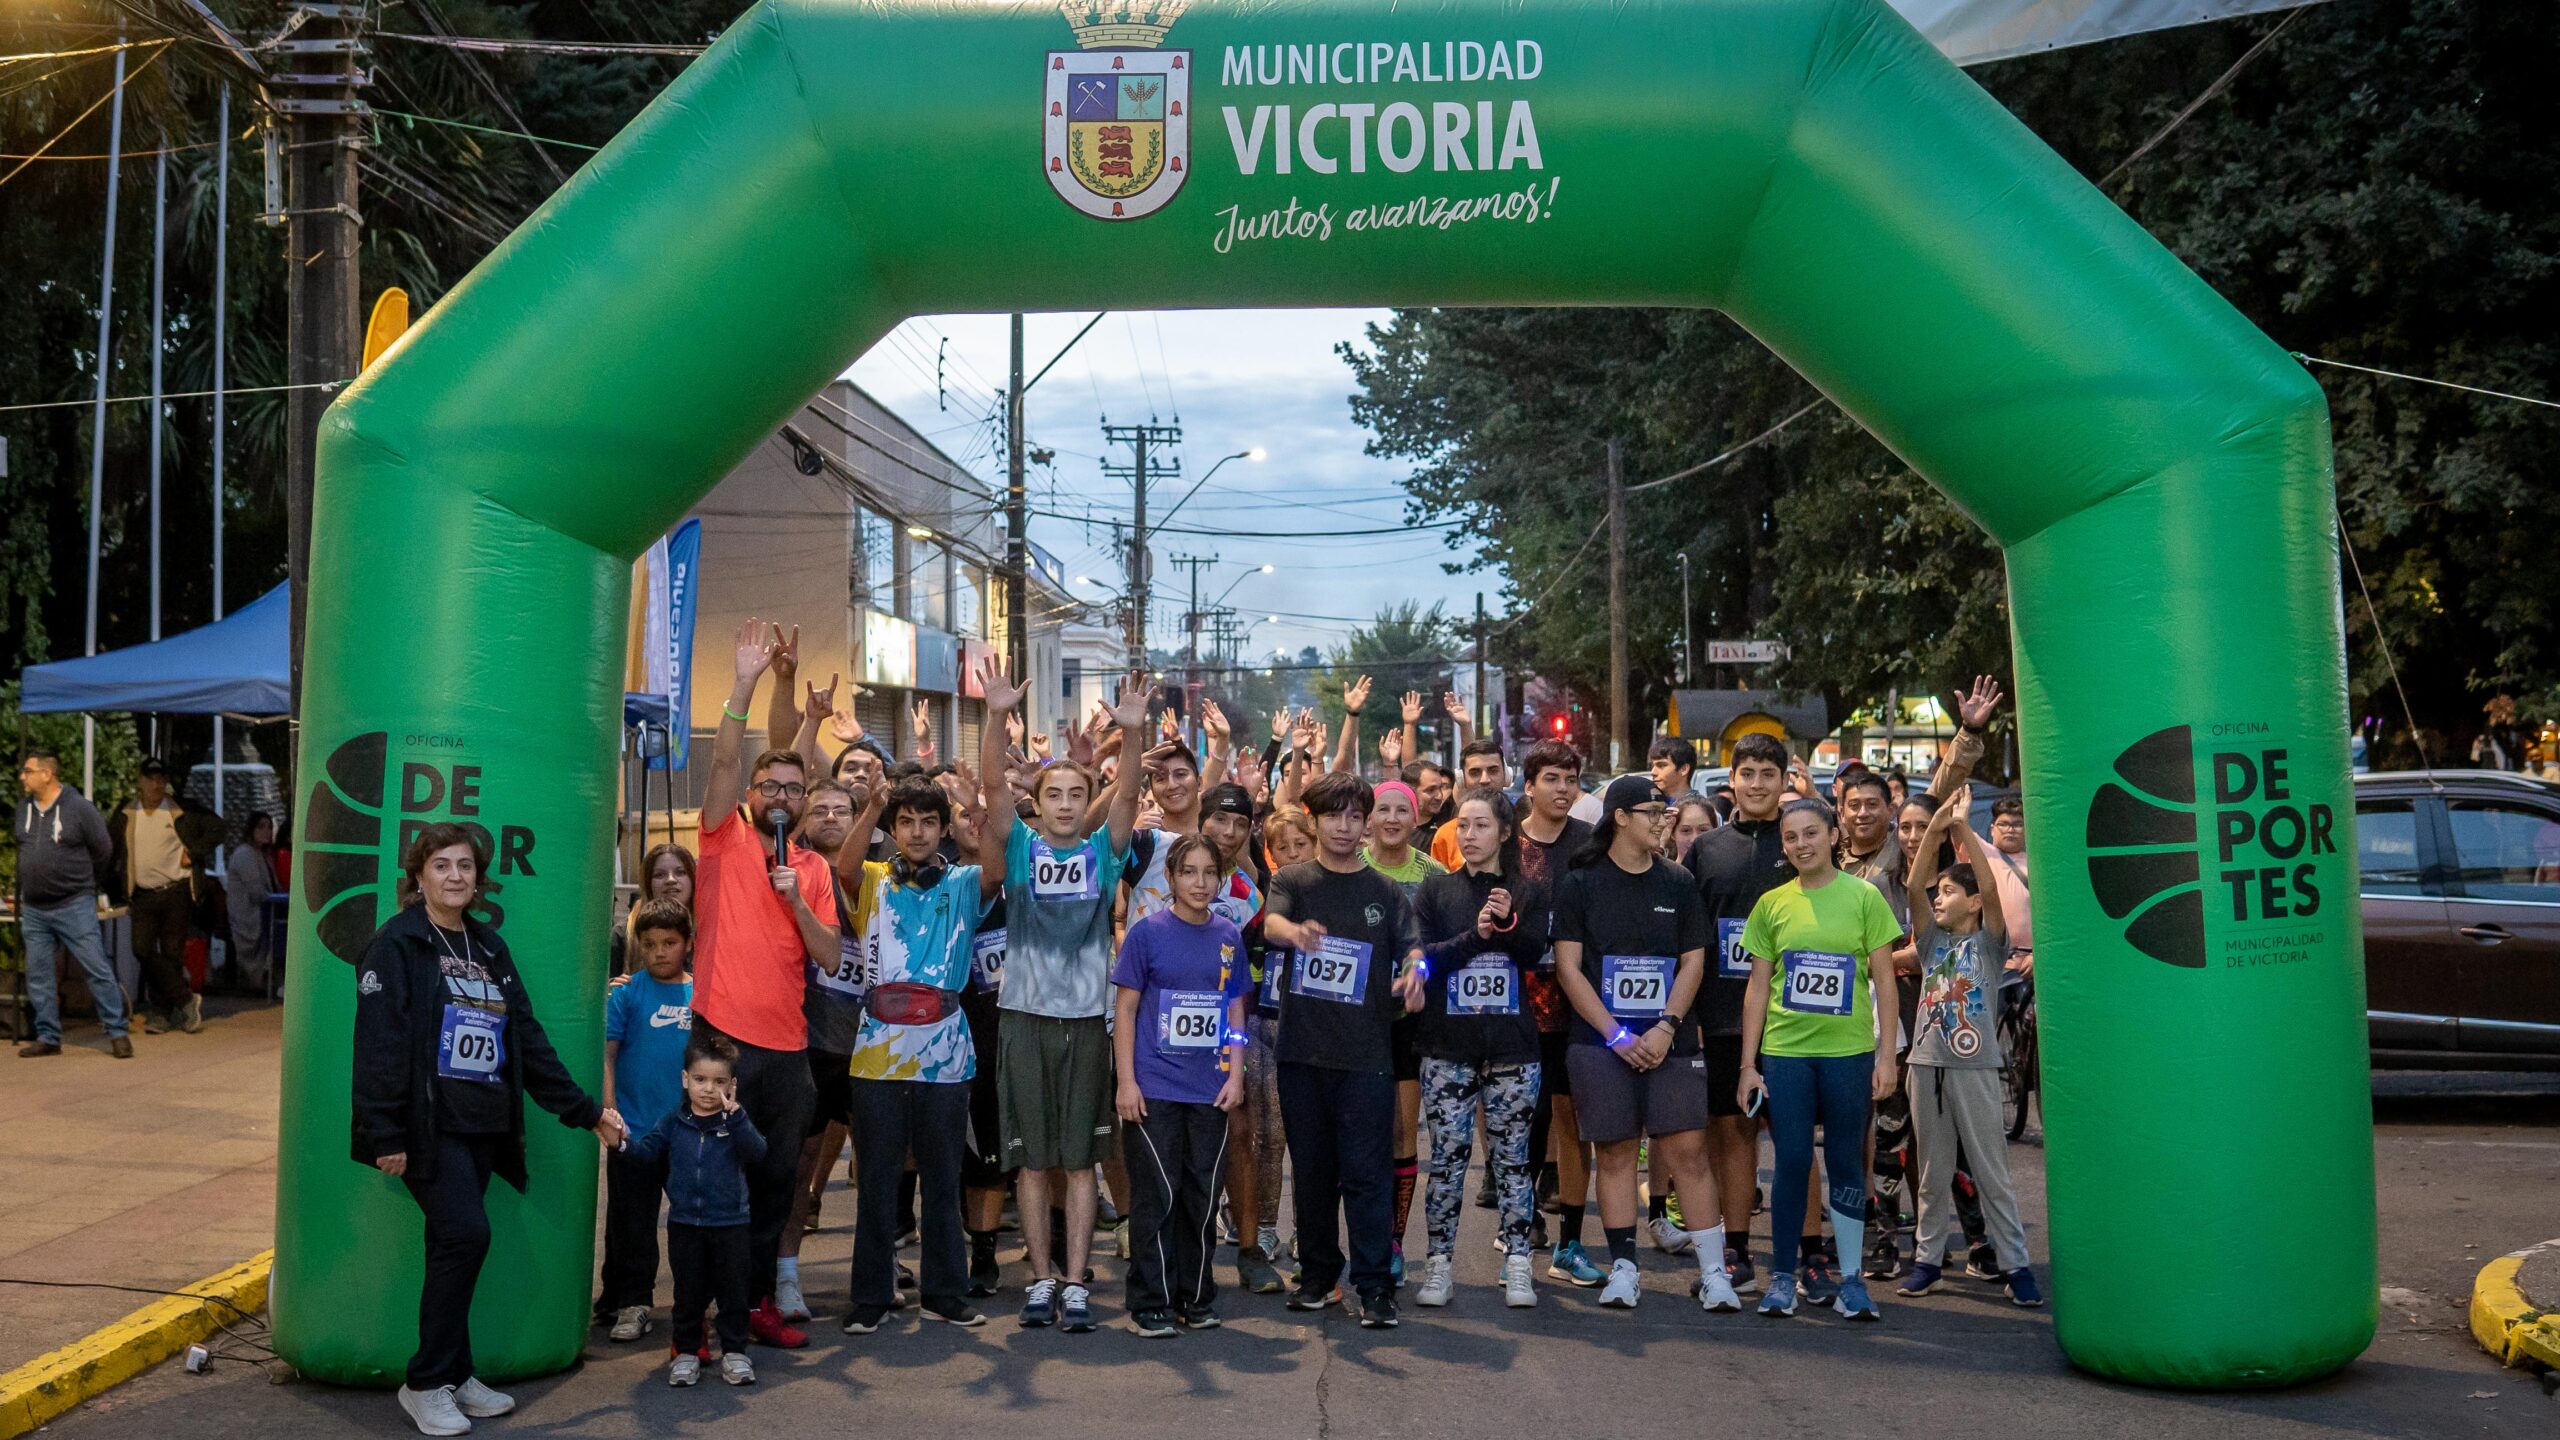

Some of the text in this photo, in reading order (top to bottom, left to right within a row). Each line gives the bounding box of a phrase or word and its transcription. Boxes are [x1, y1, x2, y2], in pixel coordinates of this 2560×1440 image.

[1222, 40, 1543, 85] MUNICIPALIDAD
[1222, 100, 1544, 175] VICTORIA
[1214, 176, 1560, 253] Juntos avanzamos!
[1711, 645, 1747, 658] Taxi
[2212, 721, 2269, 736] OFICINA
[406, 734, 464, 748] OFICINA
[2213, 749, 2290, 804] DE
[401, 762, 481, 816] DE
[2217, 804, 2337, 862] POR
[1039, 862, 1081, 884] 076
[2220, 863, 2320, 921] TES
[869, 933, 879, 965] 2023
[2225, 932, 2324, 951] MUNICIPALIDAD
[1801, 959, 1838, 967] Aniversario!
[1818, 954, 1847, 962] Nocturna
[2227, 951, 2309, 968] DE VICTORIA
[1309, 958, 1352, 983] 037
[1464, 975, 1505, 997] 038
[1619, 978, 1659, 999] 027
[1796, 972, 1838, 996] 028
[1172, 993, 1197, 1001] ¡Corrida
[658, 1004, 687, 1018] NIKE
[1176, 1014, 1216, 1037] 036
[459, 1034, 495, 1062] 073
